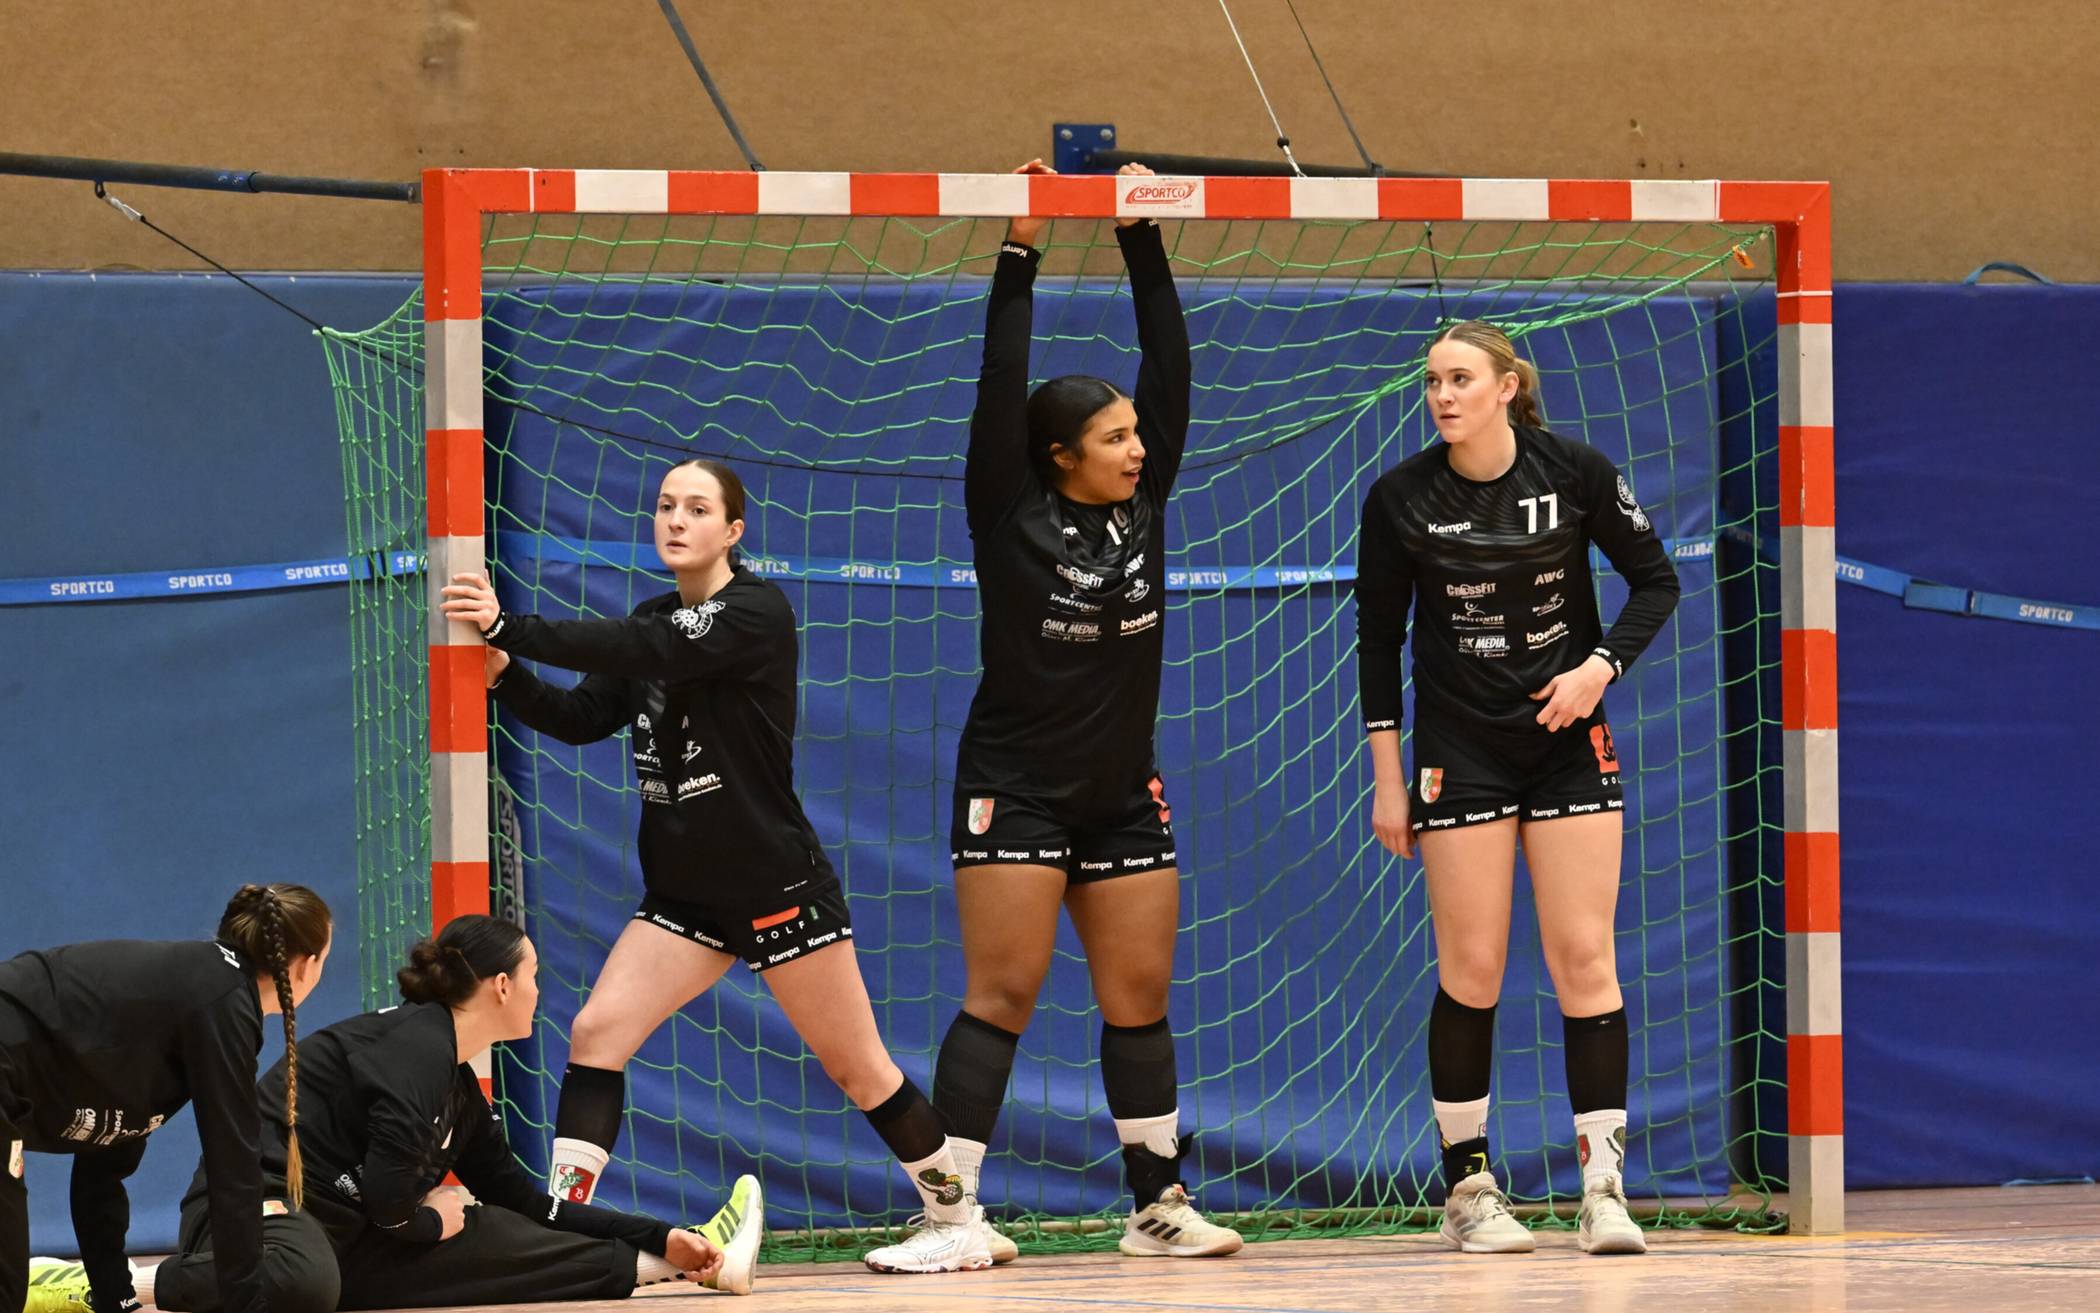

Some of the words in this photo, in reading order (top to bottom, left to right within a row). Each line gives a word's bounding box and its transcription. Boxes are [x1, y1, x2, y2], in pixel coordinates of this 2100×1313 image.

[1136, 187, 1185, 198] SPORTCO
[1518, 493, 1558, 534] 77
[1428, 521, 1472, 534] Kempa
[285, 562, 348, 581] SPORTCO
[841, 565, 901, 580] SPORTCO
[1168, 572, 1228, 586] SPORTCO
[1534, 568, 1564, 586] AWG
[51, 580, 114, 596] SPORTCO
[169, 573, 232, 589] SPORTCO
[2019, 603, 2073, 622] SPORTCO
[1367, 719, 1394, 729] Kempa
[1531, 807, 1559, 818] Kempa
[1569, 802, 1601, 813] Kempa
[1429, 817, 1456, 828] Kempa
[1465, 809, 1496, 822] Kempa
[963, 849, 988, 860] Kempa
[998, 849, 1030, 860] Kempa
[1039, 849, 1062, 860] Kempa
[1081, 861, 1113, 871] Kempa
[1124, 855, 1154, 868] Kempa
[652, 913, 685, 934] Kempa
[694, 930, 725, 949] Kempa
[768, 945, 800, 965] Kempa
[807, 930, 838, 948] Kempa
